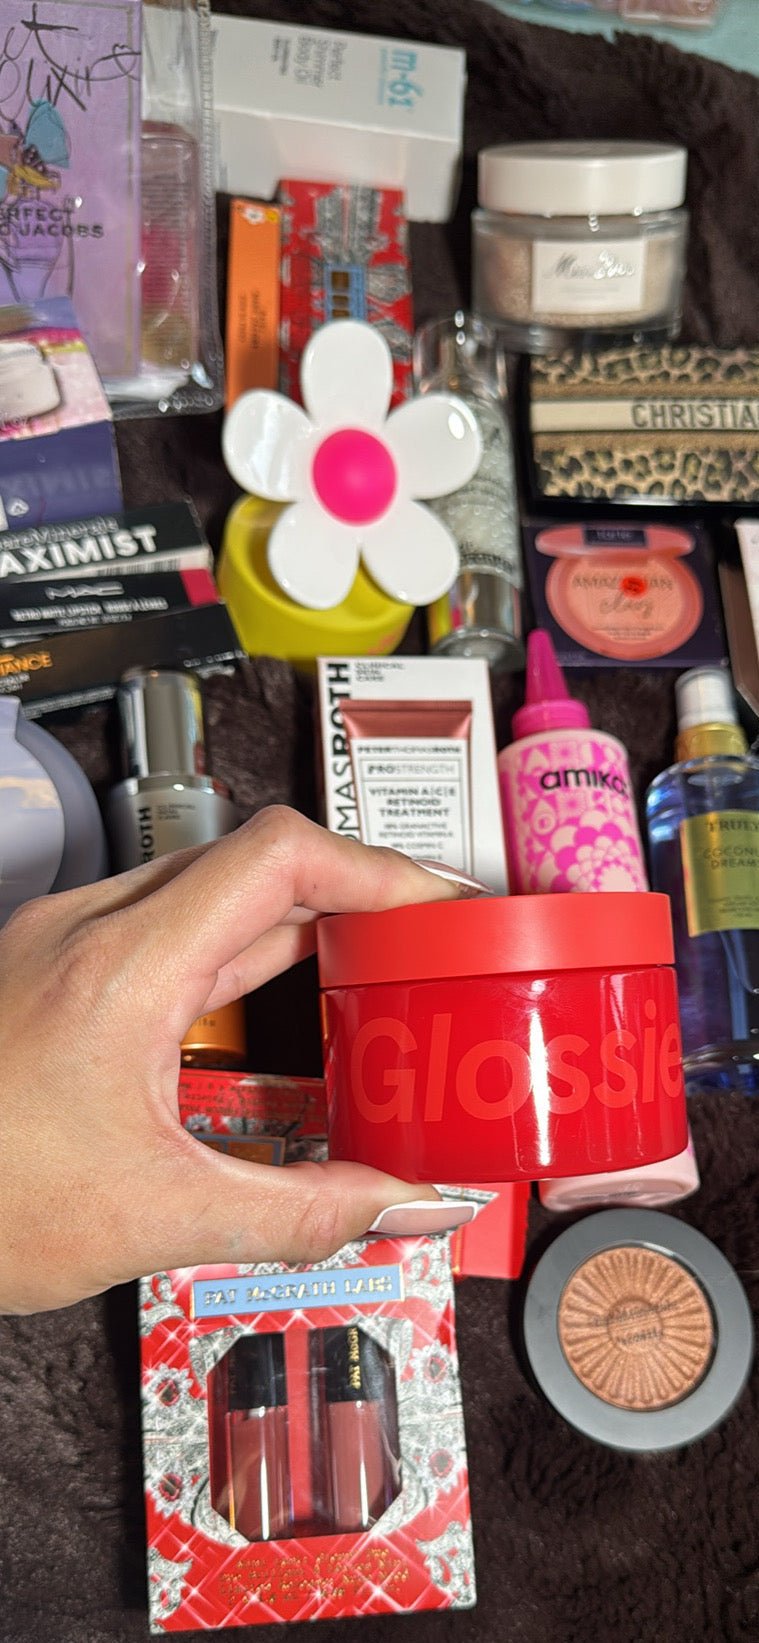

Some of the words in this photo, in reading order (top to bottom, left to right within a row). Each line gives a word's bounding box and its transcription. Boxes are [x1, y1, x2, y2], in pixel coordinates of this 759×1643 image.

[388, 49, 423, 108] m-61
[0, 207, 73, 221] ERFECT
[20, 223, 104, 239] JACOBS
[631, 403, 759, 429] CHRISTIA
[0, 524, 157, 578] AXIMIST
[0, 651, 53, 677] IANCE
[369, 787, 419, 797] VITAMIN
[379, 808, 450, 818] TREATMENT
[710, 859, 759, 870] DREAM
[350, 999, 683, 1123] Glossie
[204, 1290, 237, 1306] PAT
[344, 1275, 393, 1295] LABS
